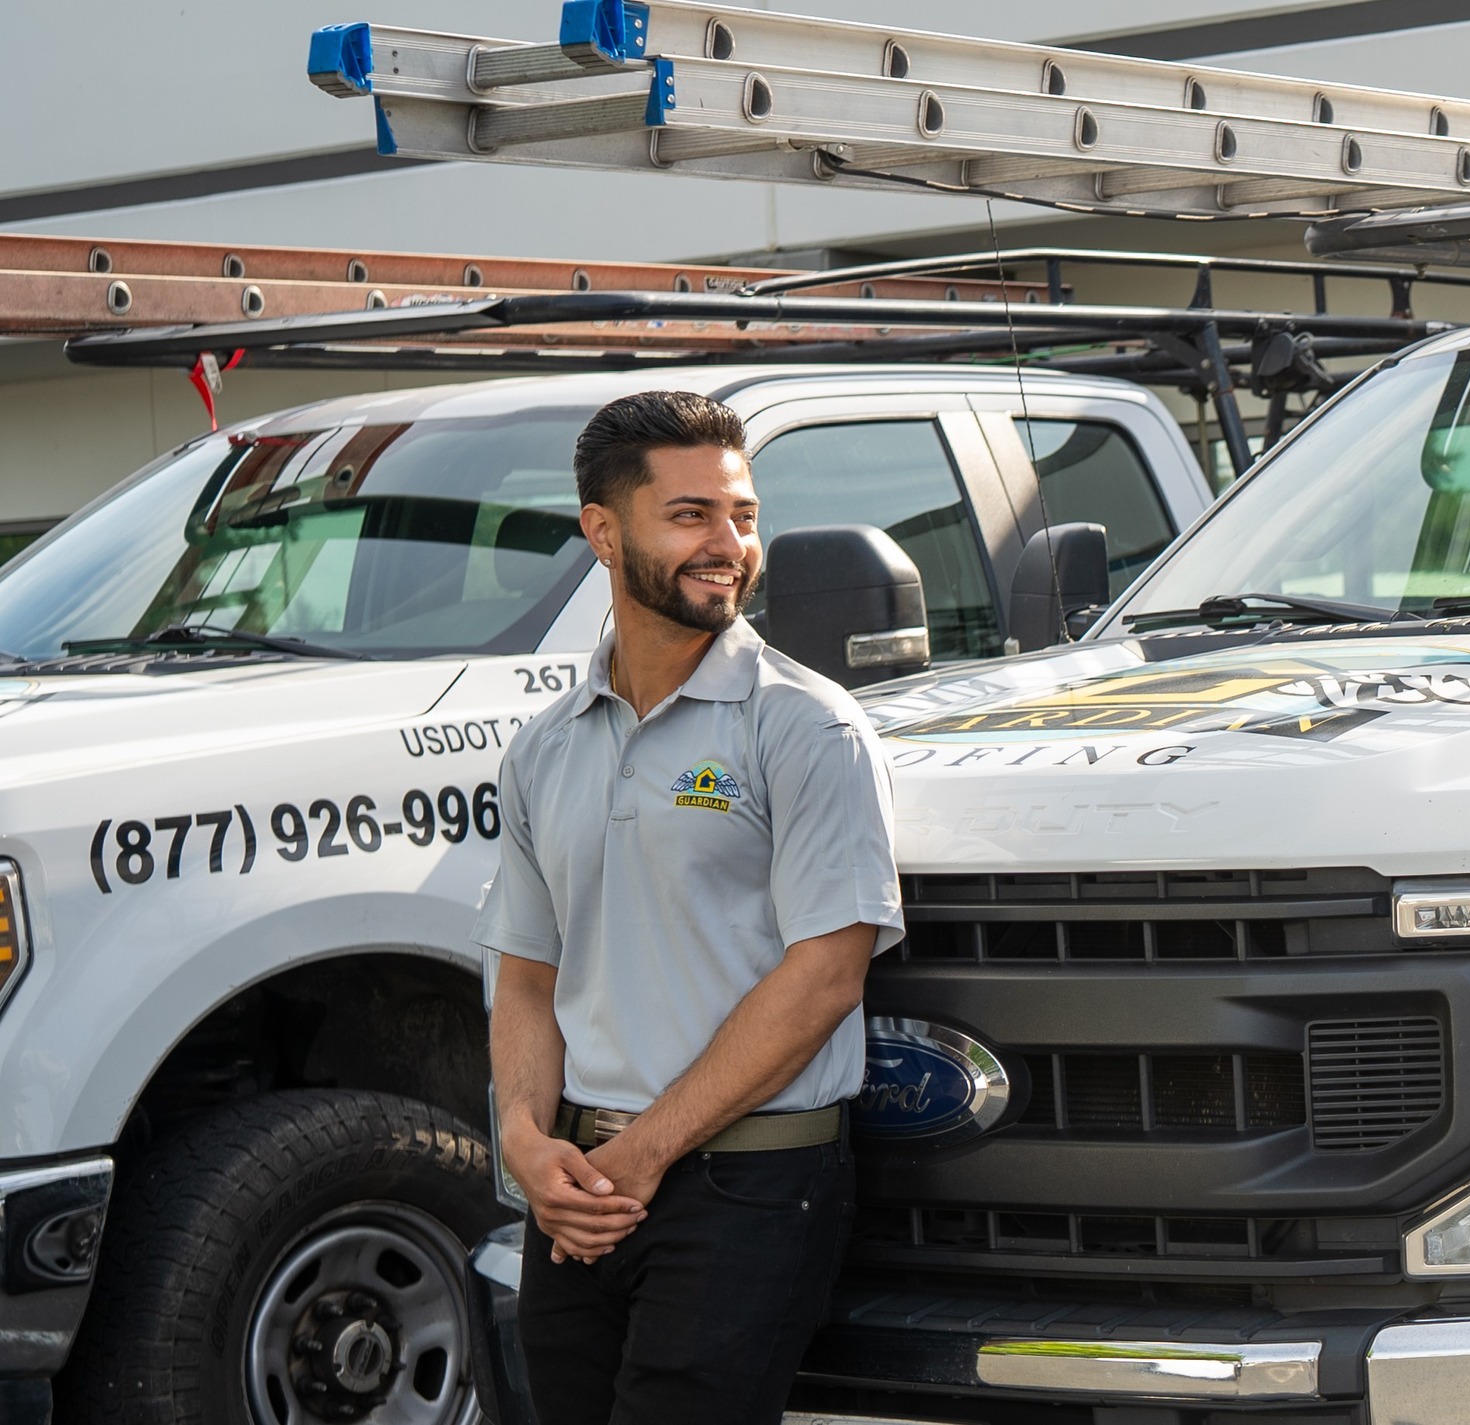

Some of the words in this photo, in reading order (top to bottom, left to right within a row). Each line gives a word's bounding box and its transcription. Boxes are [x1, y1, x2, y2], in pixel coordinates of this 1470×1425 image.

[514, 664, 577, 693] 267
[912, 709, 1350, 733] ARDIAN
[400, 719, 502, 758] USDOT
[893, 744, 1198, 769] OFING
[677, 796, 728, 811] GUARDIAN
[954, 799, 1221, 837] DUTY
[89, 803, 258, 894] (877)
[270, 782, 501, 863] 926-996
[861, 1057, 931, 1113] ord
